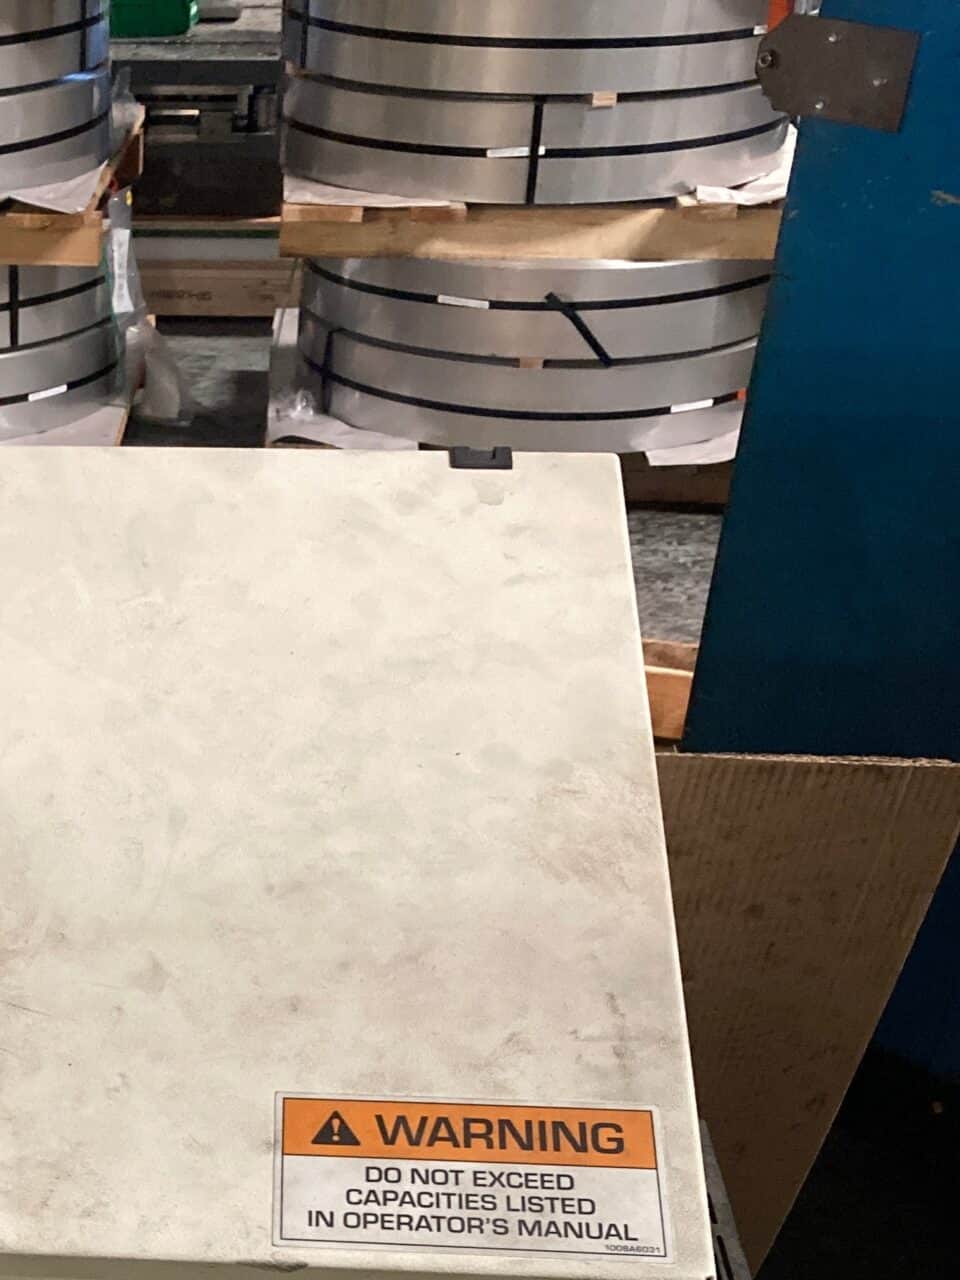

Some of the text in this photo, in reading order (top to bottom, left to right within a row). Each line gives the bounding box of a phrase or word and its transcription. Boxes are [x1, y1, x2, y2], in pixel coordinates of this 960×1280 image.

[374, 1112, 626, 1156] WARNING
[365, 1165, 576, 1191] DO NOT EXCEED
[344, 1188, 597, 1216] CAPACITIES LISTED
[307, 1210, 640, 1242] IN OPERATOR'S MANUAL
